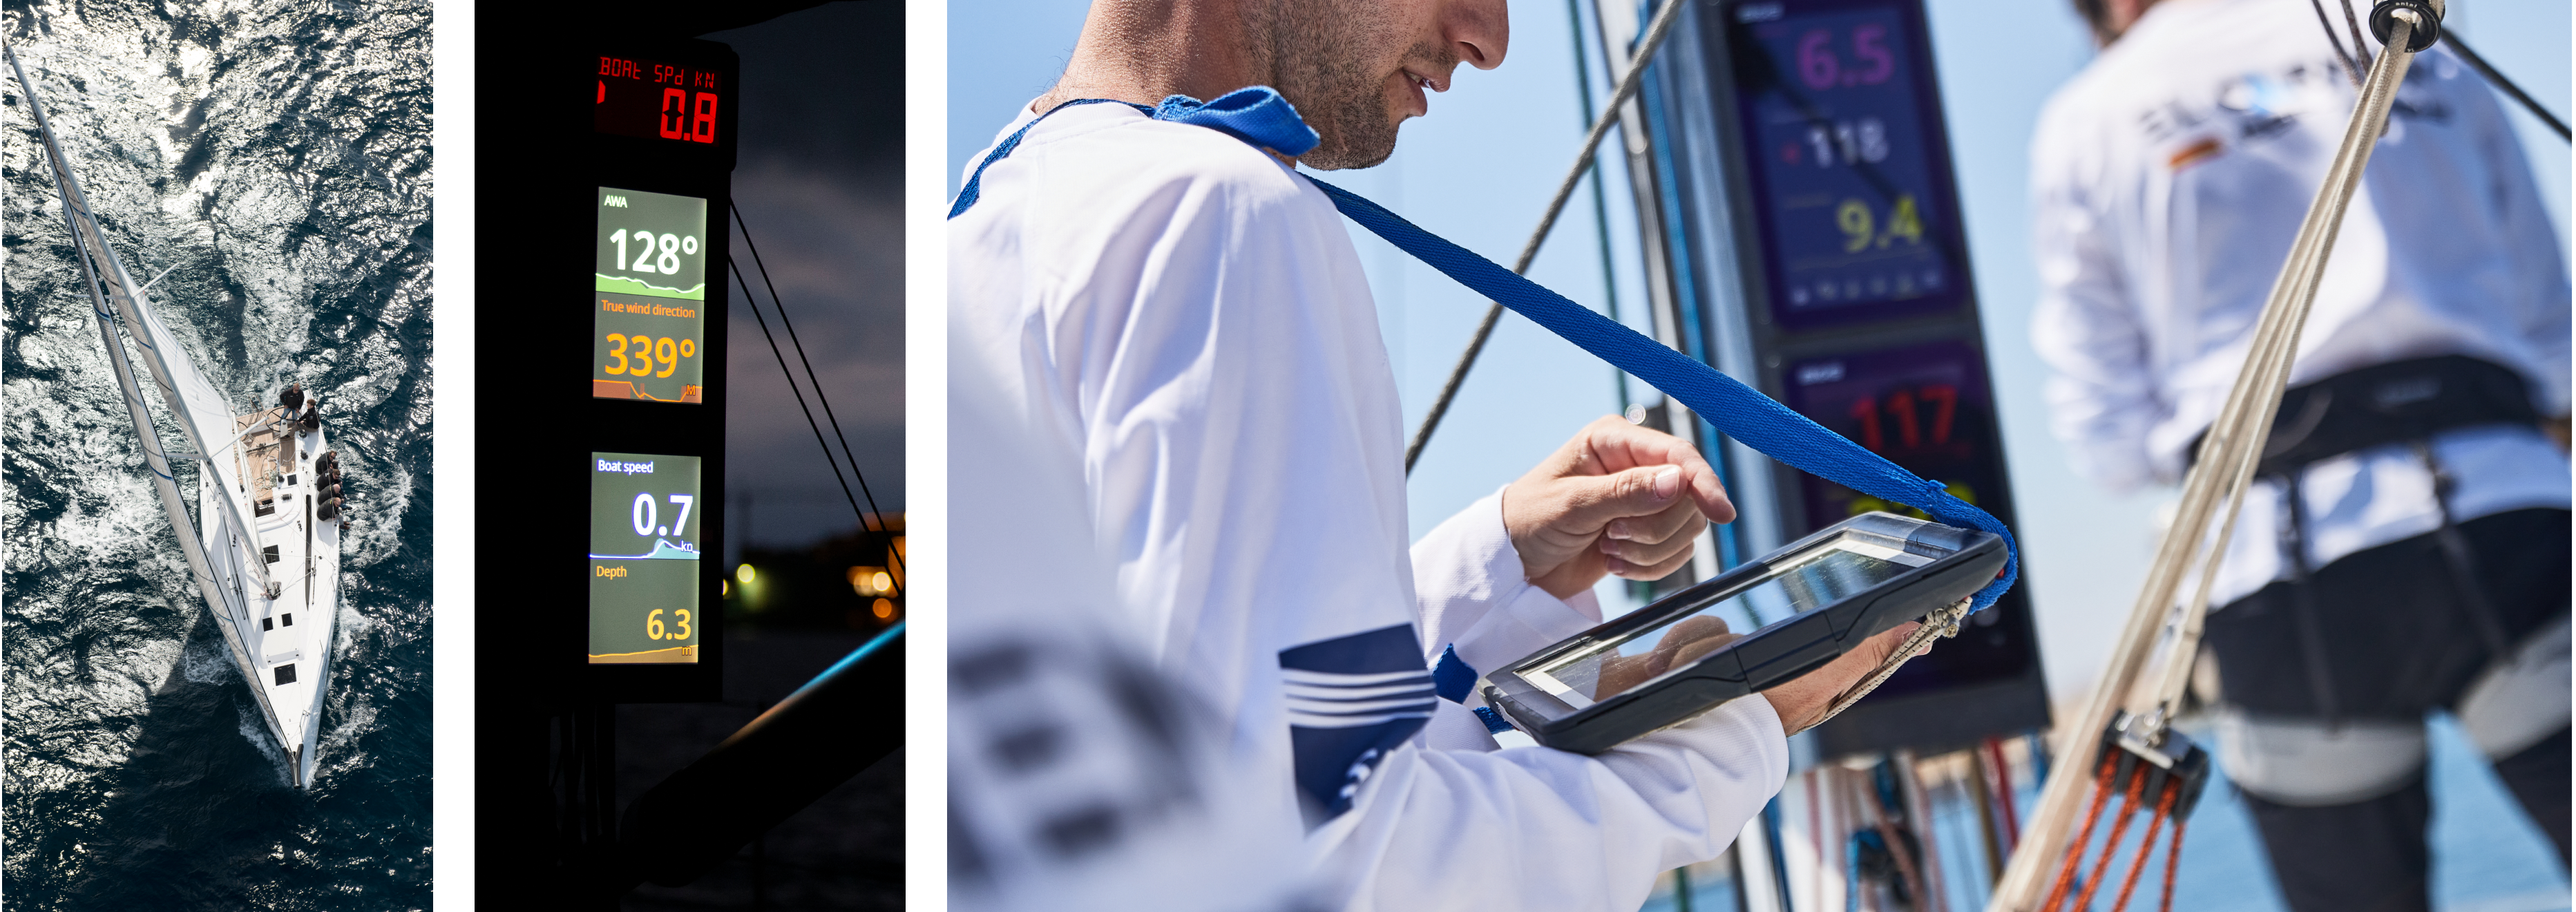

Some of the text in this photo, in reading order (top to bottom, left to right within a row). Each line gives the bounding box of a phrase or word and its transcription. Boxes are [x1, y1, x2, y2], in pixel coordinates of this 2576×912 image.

[1797, 22, 1895, 91] 6.5
[695, 70, 714, 89] KN
[660, 87, 718, 144] 0.8
[1806, 117, 1889, 168] 118
[604, 195, 628, 208] AWA
[1837, 191, 1923, 253] 9.4
[609, 229, 698, 275] 128°
[601, 299, 695, 319] True wind direction
[604, 333, 696, 379] 339°
[686, 384, 696, 396] M
[1851, 386, 1958, 452] 117
[598, 459, 653, 475] Boat speed
[632, 493, 694, 537] 0.7
[680, 540, 694, 552] kn
[596, 566, 627, 580] Depth
[647, 609, 691, 640] 6.3
[681, 646, 691, 656] m
